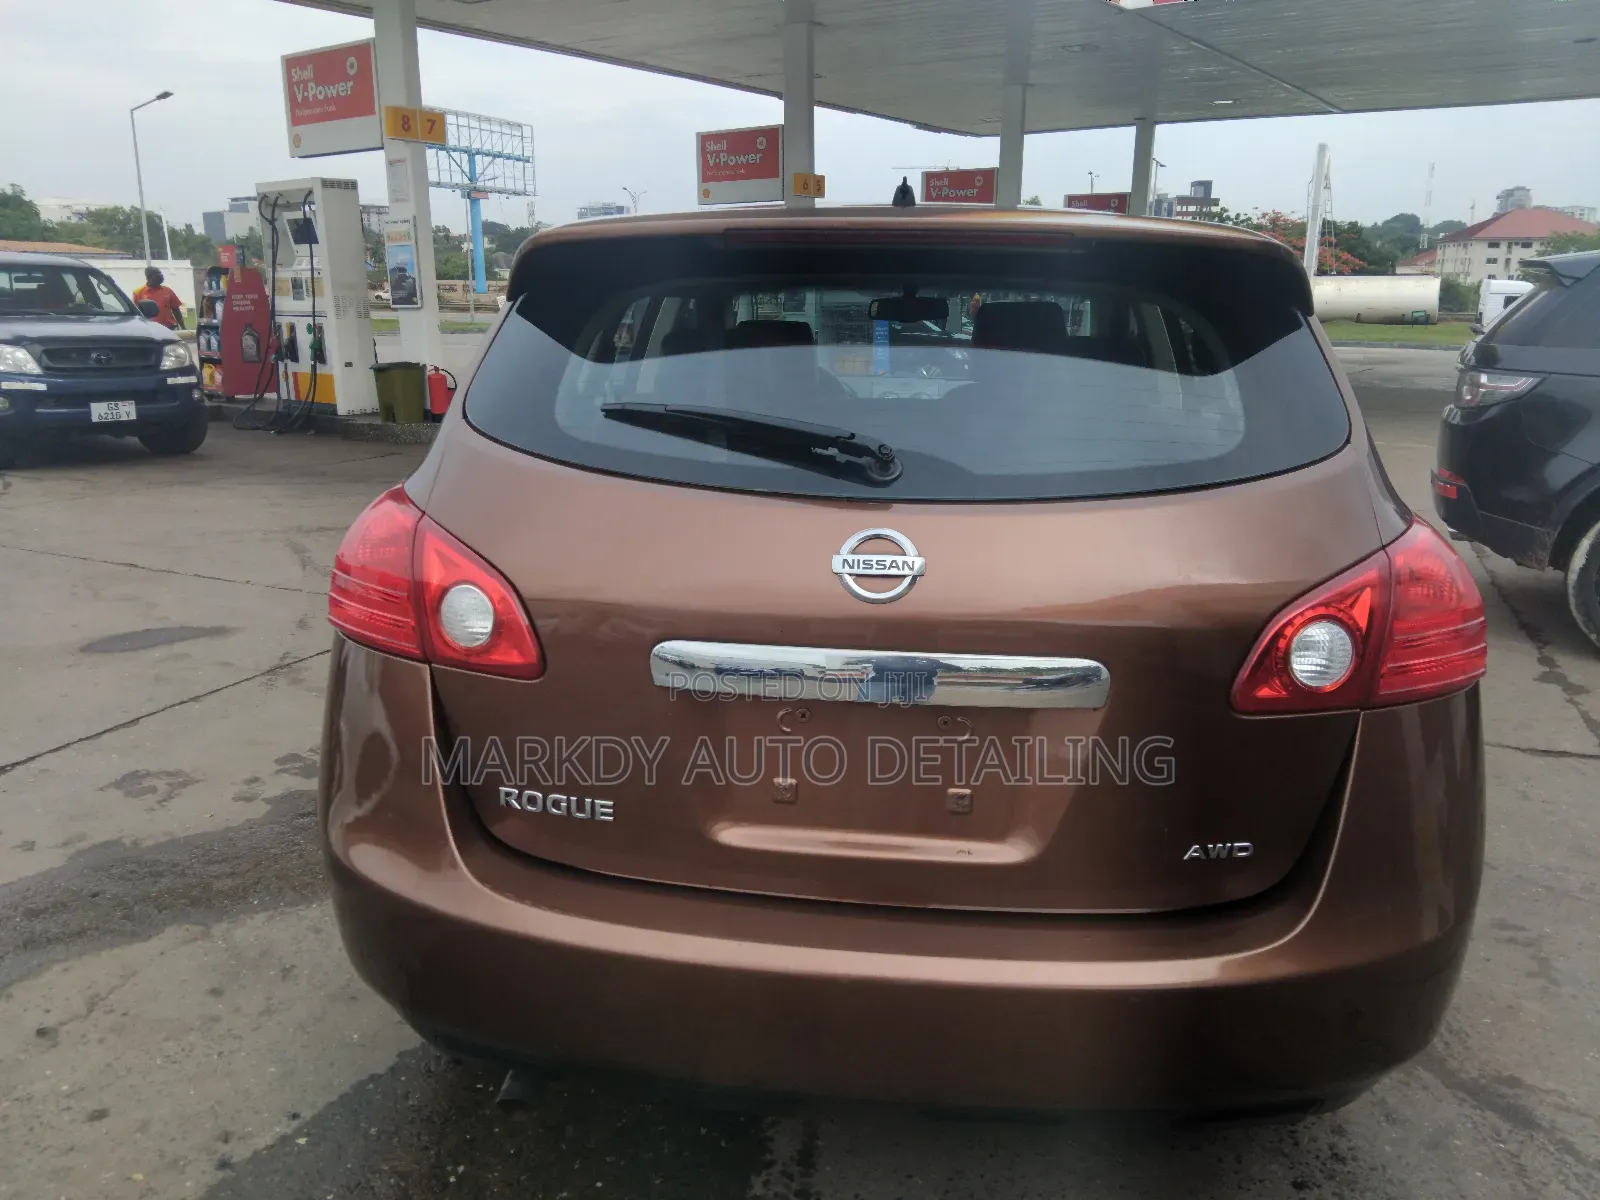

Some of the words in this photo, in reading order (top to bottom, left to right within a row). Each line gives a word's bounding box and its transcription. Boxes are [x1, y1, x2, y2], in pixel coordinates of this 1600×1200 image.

[291, 64, 313, 82] Shell
[294, 79, 354, 104] V-Power
[401, 114, 411, 133] 8
[426, 118, 436, 135] 7
[705, 139, 727, 152] Shell
[706, 152, 762, 167] V-Power
[803, 179, 808, 191] 6
[816, 180, 821, 193] 5
[929, 177, 949, 187] Shell
[930, 187, 979, 199] V-Power
[1071, 199, 1088, 208] Shell
[107, 402, 120, 411] GS
[125, 411, 130, 419] Y
[841, 558, 916, 572] NISSAN
[498, 786, 615, 821] ROGUE
[1182, 841, 1255, 861] AWD
